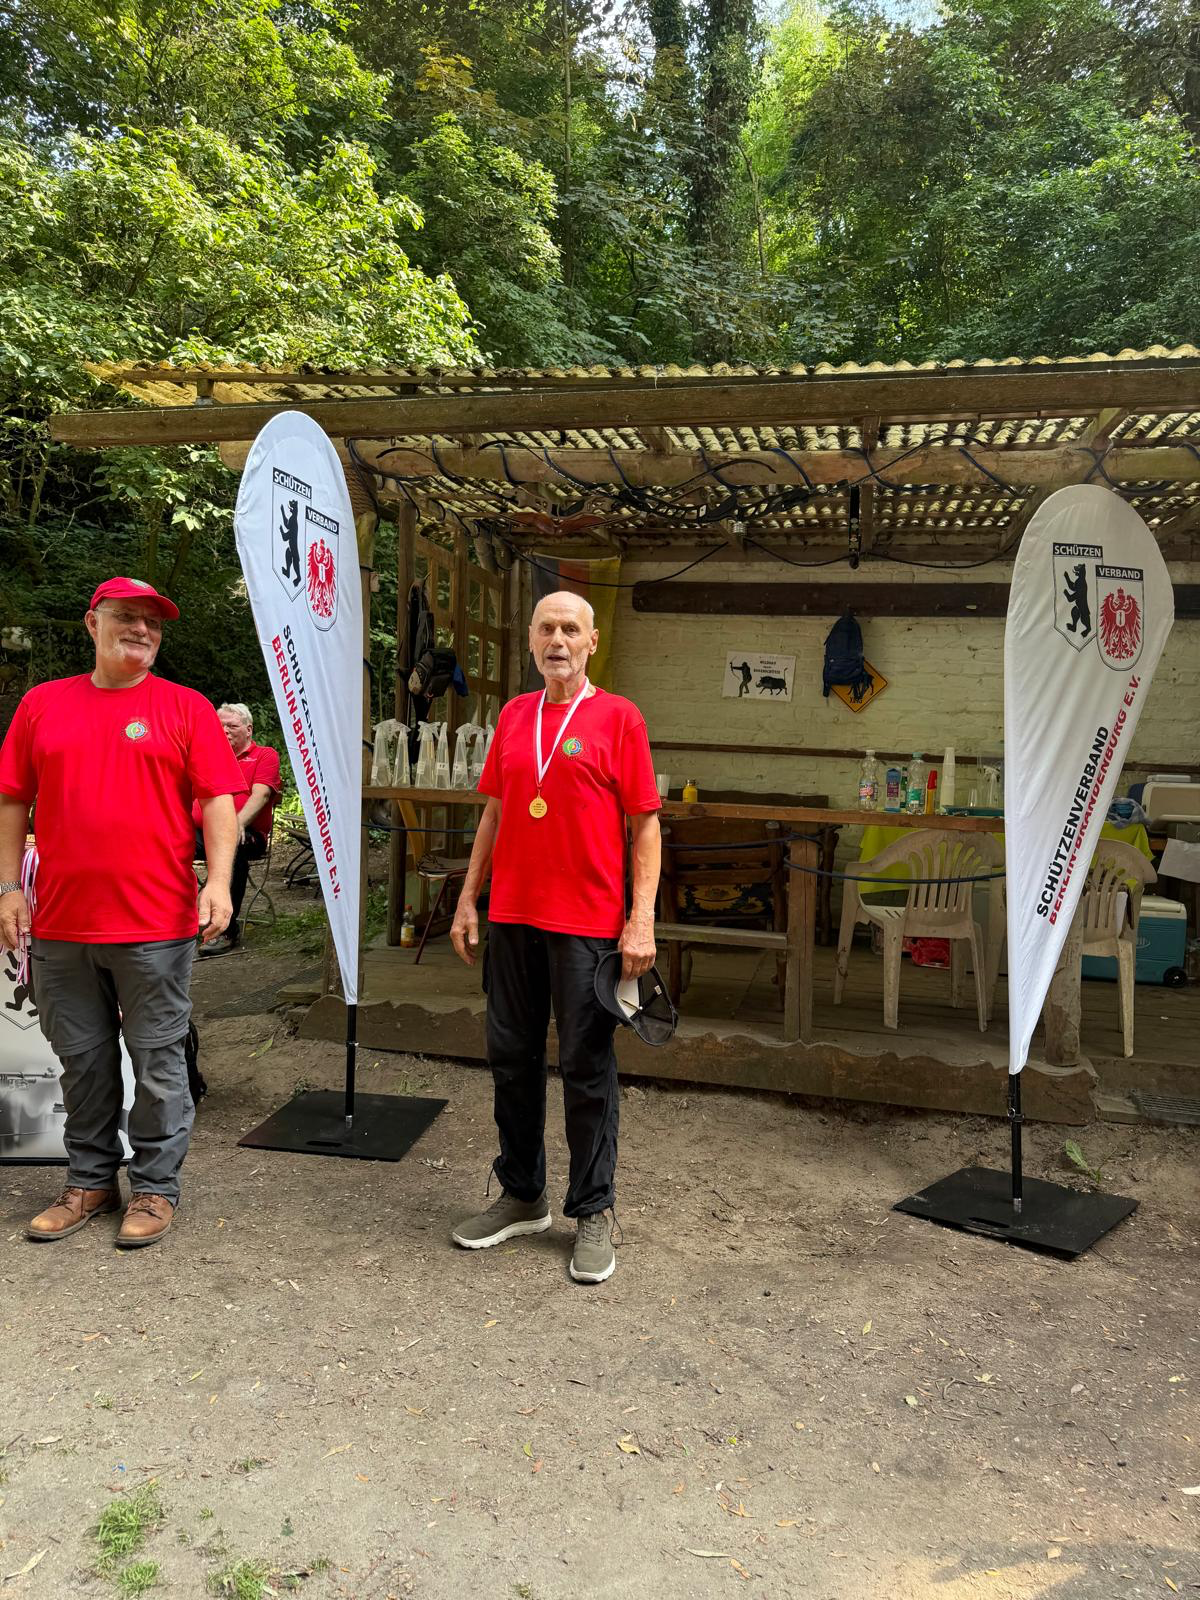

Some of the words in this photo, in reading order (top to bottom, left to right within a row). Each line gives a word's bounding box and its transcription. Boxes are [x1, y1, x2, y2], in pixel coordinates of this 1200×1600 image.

[274, 471, 311, 498] SCHÜTZEN
[308, 509, 338, 533] VERBAND
[1054, 545, 1101, 557] SCHÜTZEN
[1099, 567, 1141, 580] VERBAND
[1123, 674, 1141, 707] E.V.
[271, 635, 335, 863] BERLIN-BRANDENBURG
[329, 864, 341, 900] E.V.
[1036, 726, 1109, 918] SCHÜTZENVERBAND
